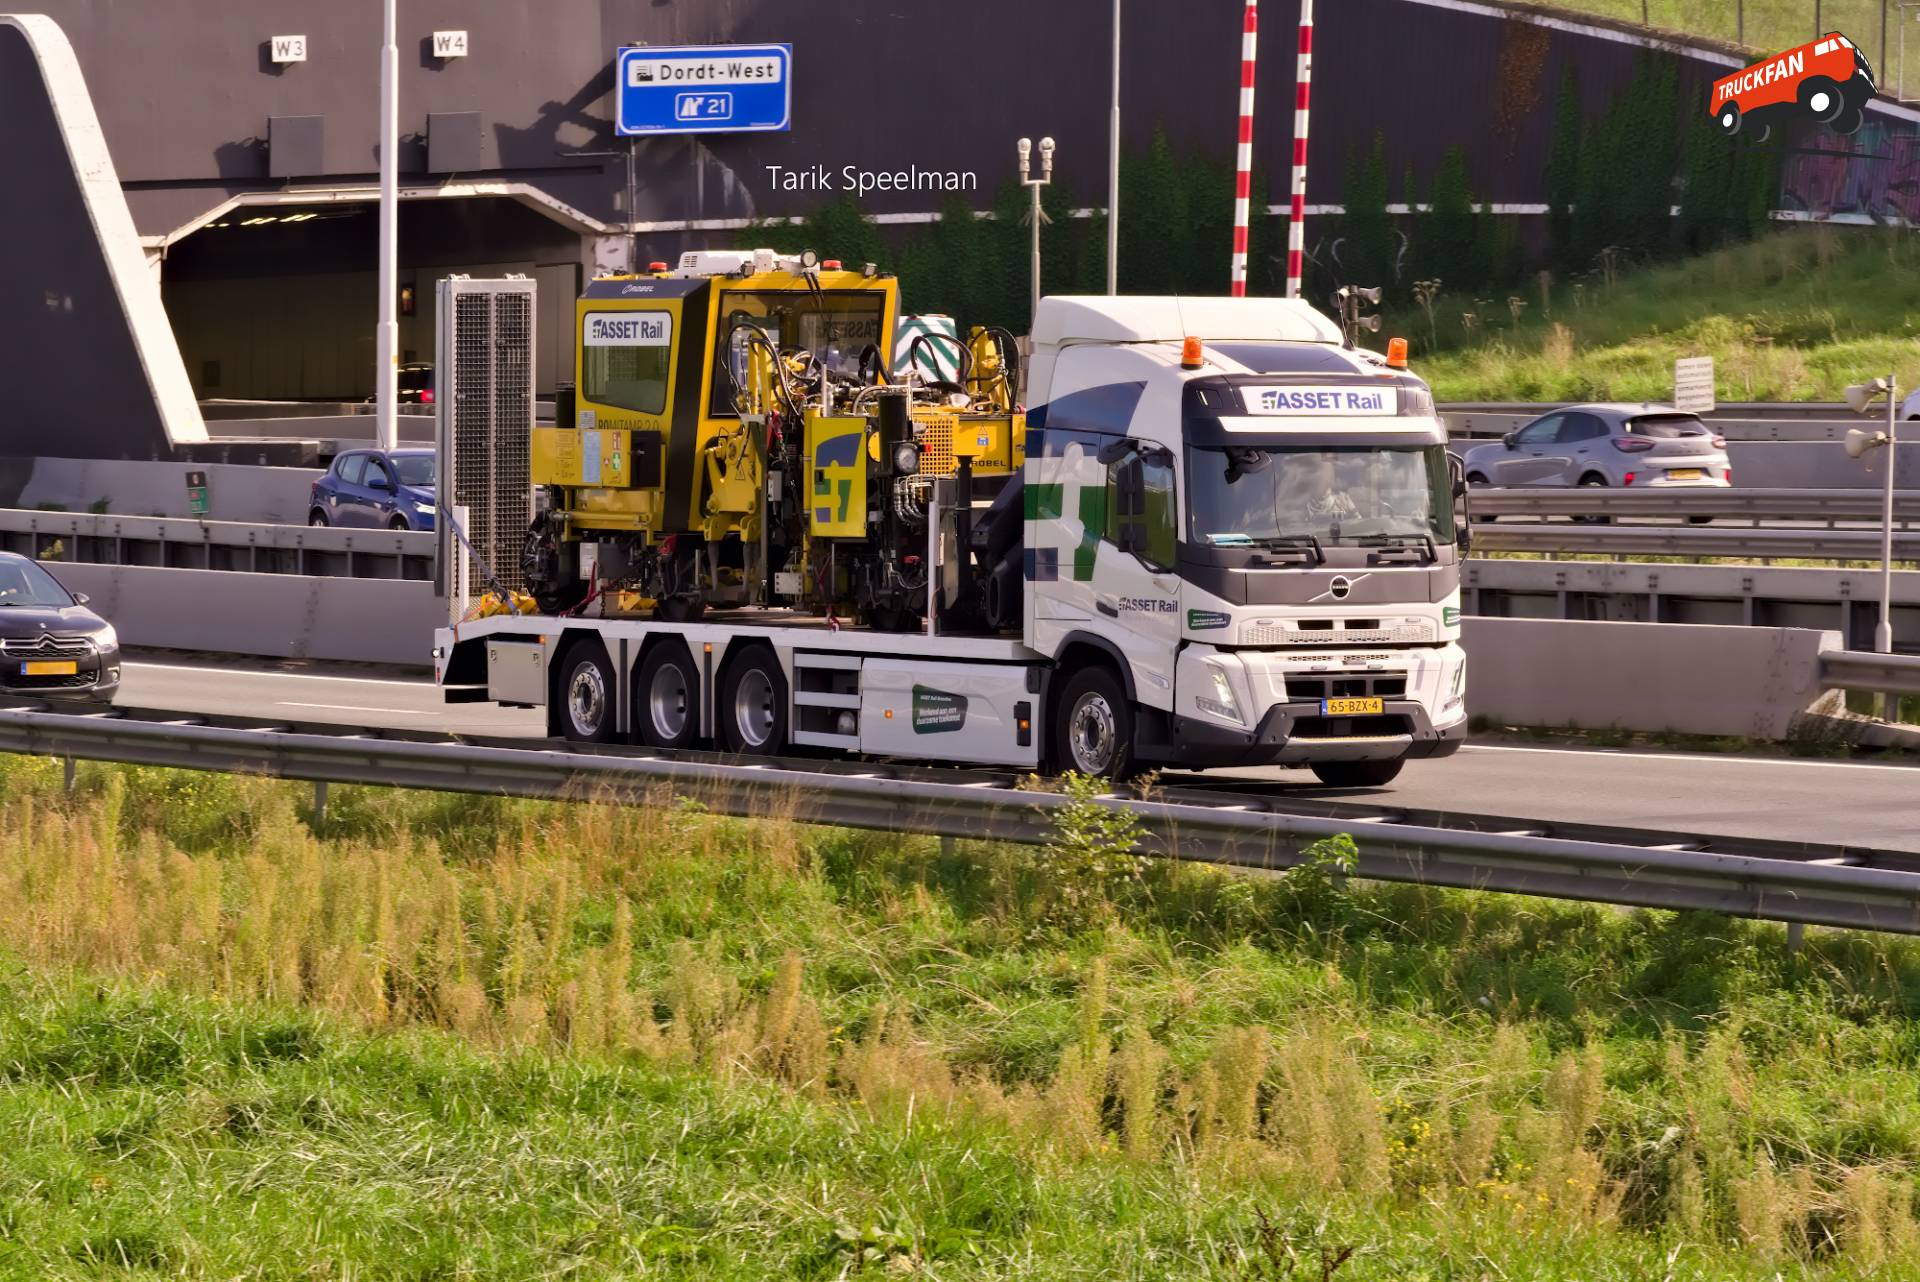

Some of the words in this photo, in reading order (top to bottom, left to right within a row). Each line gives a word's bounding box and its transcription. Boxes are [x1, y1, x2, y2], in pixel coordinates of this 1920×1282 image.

[276, 41, 291, 57] W
[294, 40, 303, 56] 3
[436, 37, 450, 52] W
[454, 36, 464, 51] 4
[660, 63, 774, 80] Dordt-West
[707, 99, 725, 113] 21
[601, 321, 638, 339] ASSET
[641, 321, 663, 339] Rail
[1277, 392, 1341, 409] ASSET
[1346, 393, 1383, 410] Rail
[1125, 599, 1157, 612] ASSET
[1159, 600, 1178, 612] Rail
[1330, 700, 1378, 712] 65-BZX-4
